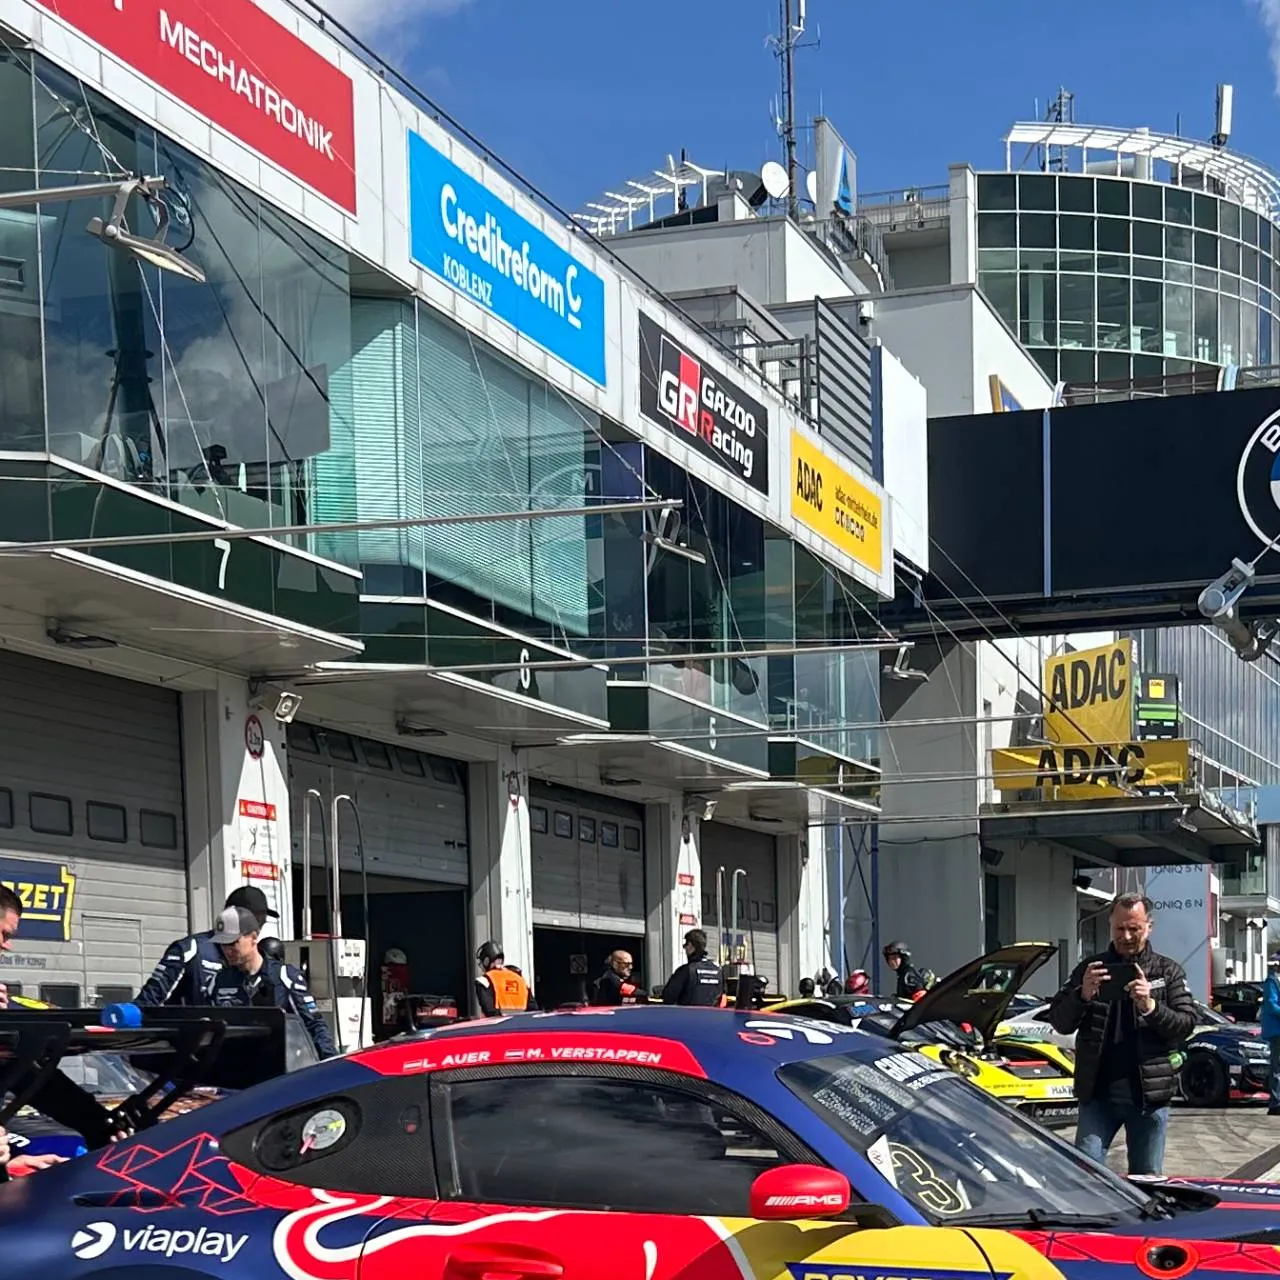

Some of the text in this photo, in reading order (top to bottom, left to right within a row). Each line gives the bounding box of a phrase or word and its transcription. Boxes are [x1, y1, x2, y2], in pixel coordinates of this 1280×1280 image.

[160, 9, 335, 161] MECHATRONIK
[440, 183, 565, 318] Creditreform
[443, 252, 493, 307] KOBLENZ
[660, 369, 697, 430] GR
[702, 377, 756, 438] GAZOO
[701, 410, 754, 478] Racing
[797, 457, 823, 512] ADAC
[214, 538, 231, 590] 7
[521, 649, 531, 690] 6
[1050, 648, 1126, 713] ADAC
[1036, 745, 1146, 787] ADAC
[1195, 864, 1203, 873] N
[2, 881, 65, 910] ZET
[1153, 898, 1203, 911] ONIQ 6 N
[0, 954, 11, 966] Das
[421, 1047, 662, 1069] L. AUER M. VERSTAPPEN
[887, 1142, 966, 1214] 3
[123, 1224, 249, 1262] viaplay
